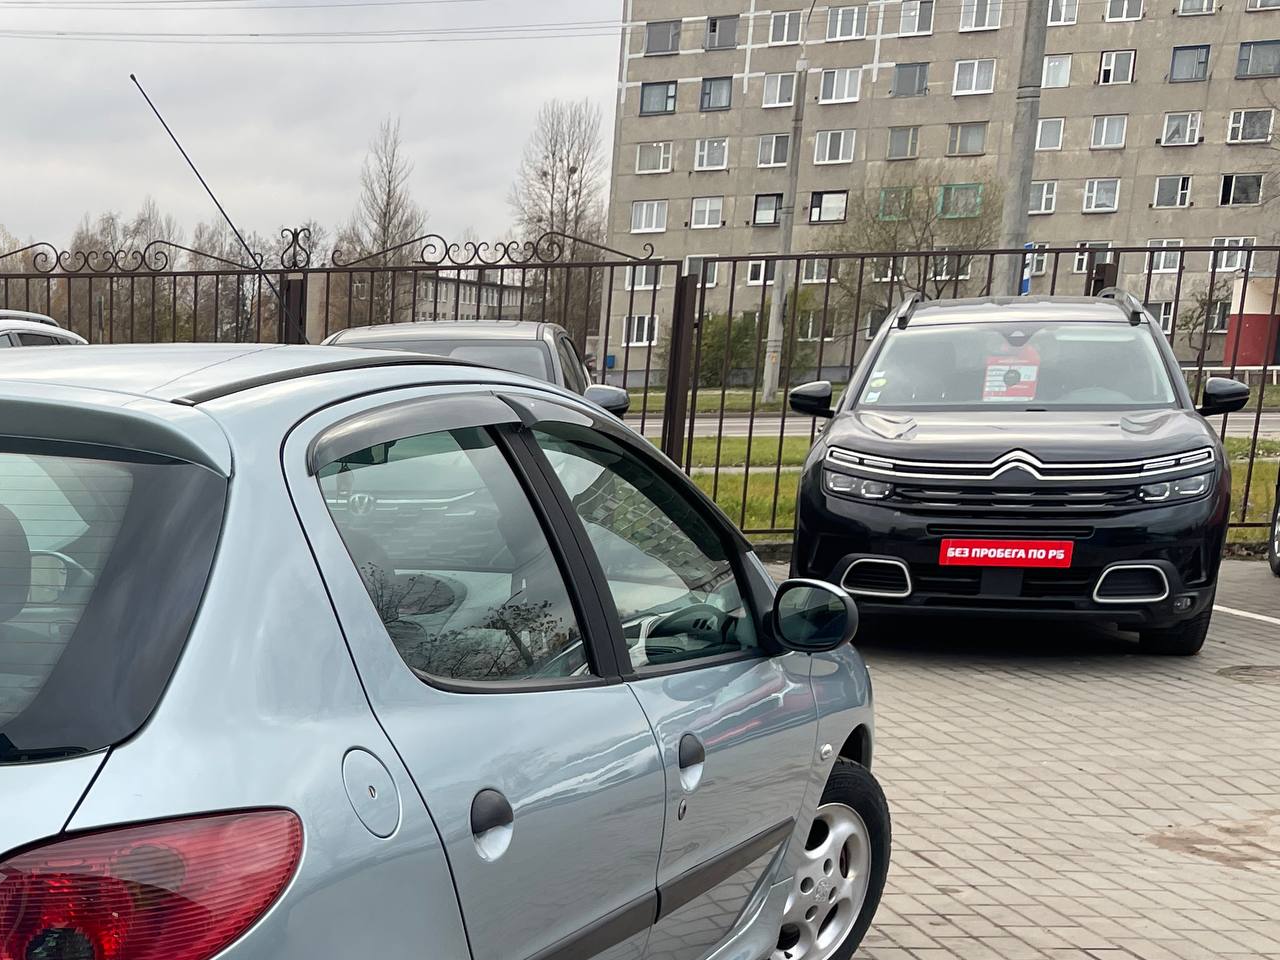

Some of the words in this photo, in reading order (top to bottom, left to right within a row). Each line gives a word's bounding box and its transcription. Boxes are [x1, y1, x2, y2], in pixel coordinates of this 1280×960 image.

[947, 547, 969, 558] БЕЗ
[971, 547, 1026, 559] ПРОБЕГА
[1027, 549, 1046, 559] ПО
[1047, 550, 1065, 560] РБ
